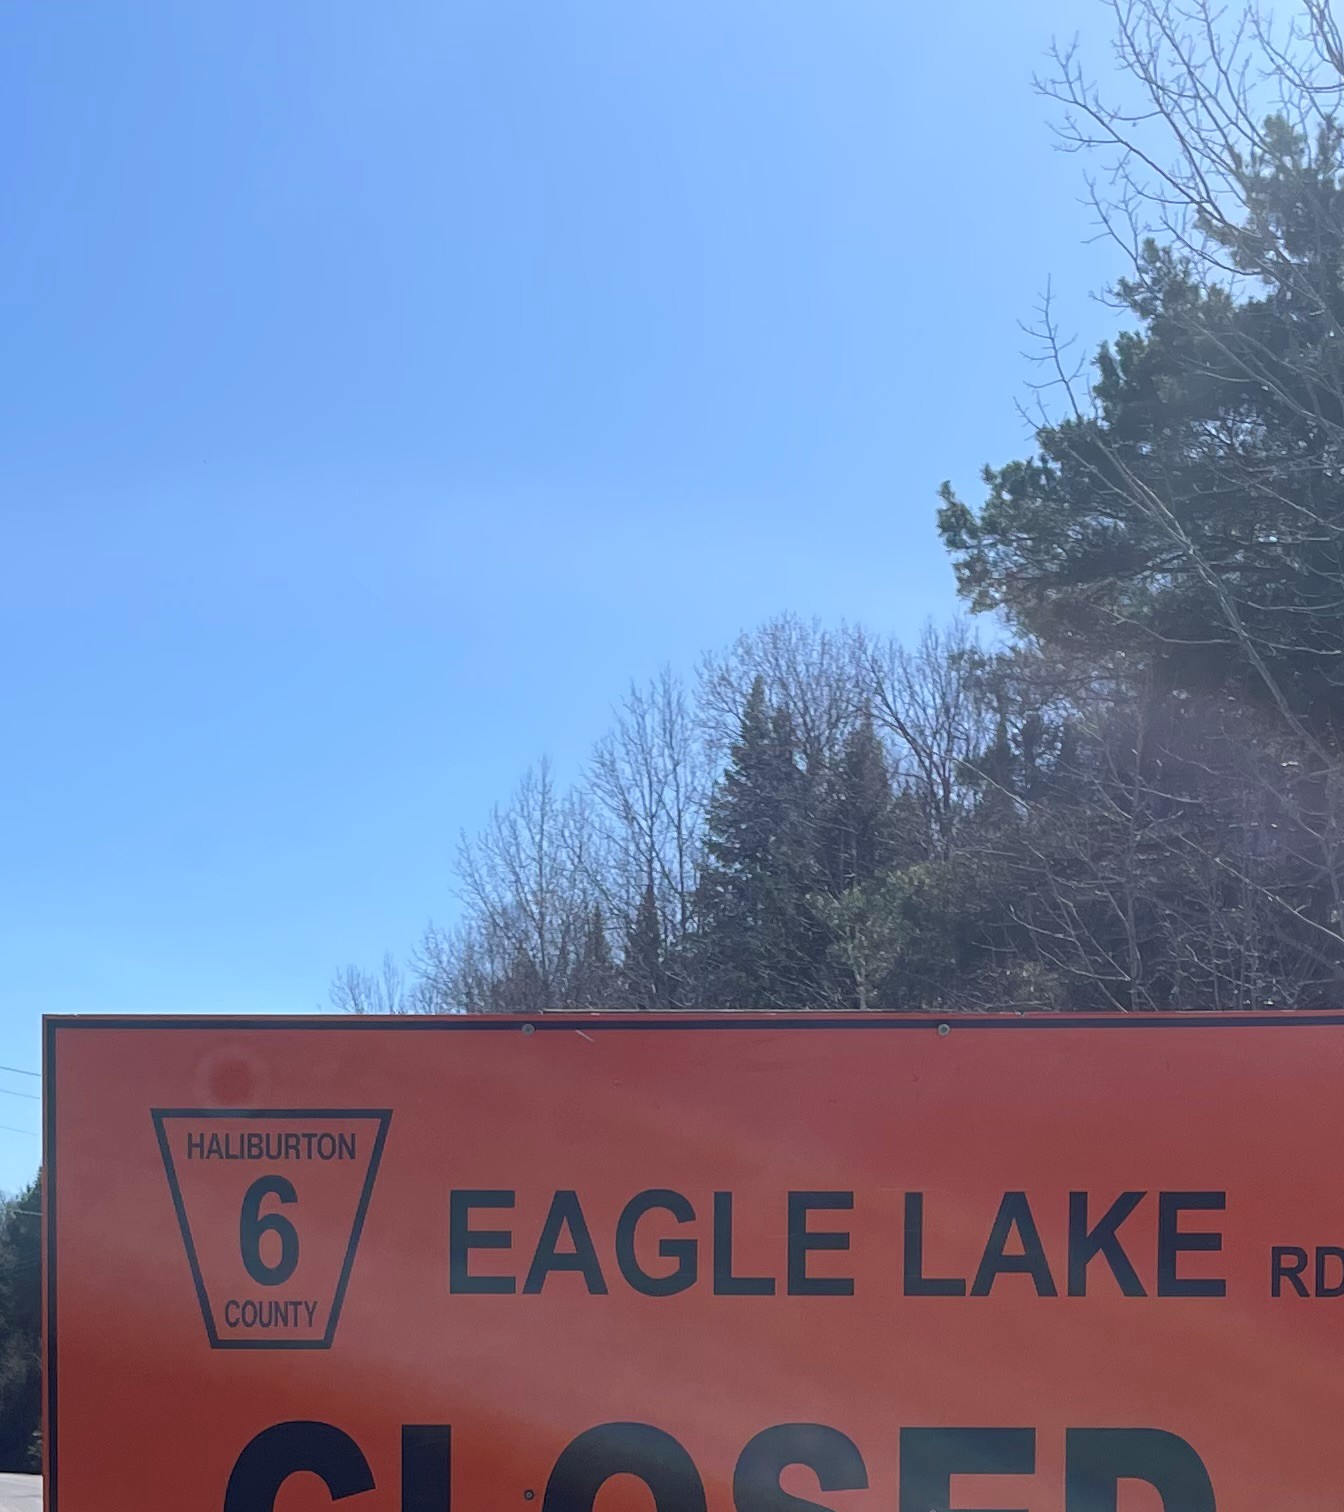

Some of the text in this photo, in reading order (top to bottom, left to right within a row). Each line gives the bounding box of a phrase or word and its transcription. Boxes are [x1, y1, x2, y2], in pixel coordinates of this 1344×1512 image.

[186, 1132, 357, 1162] HALIBURTON
[237, 1173, 301, 1288] 6
[447, 1187, 856, 1298] EAGLE
[902, 1189, 1228, 1299] LAKE
[223, 1298, 320, 1330] COUNTY
